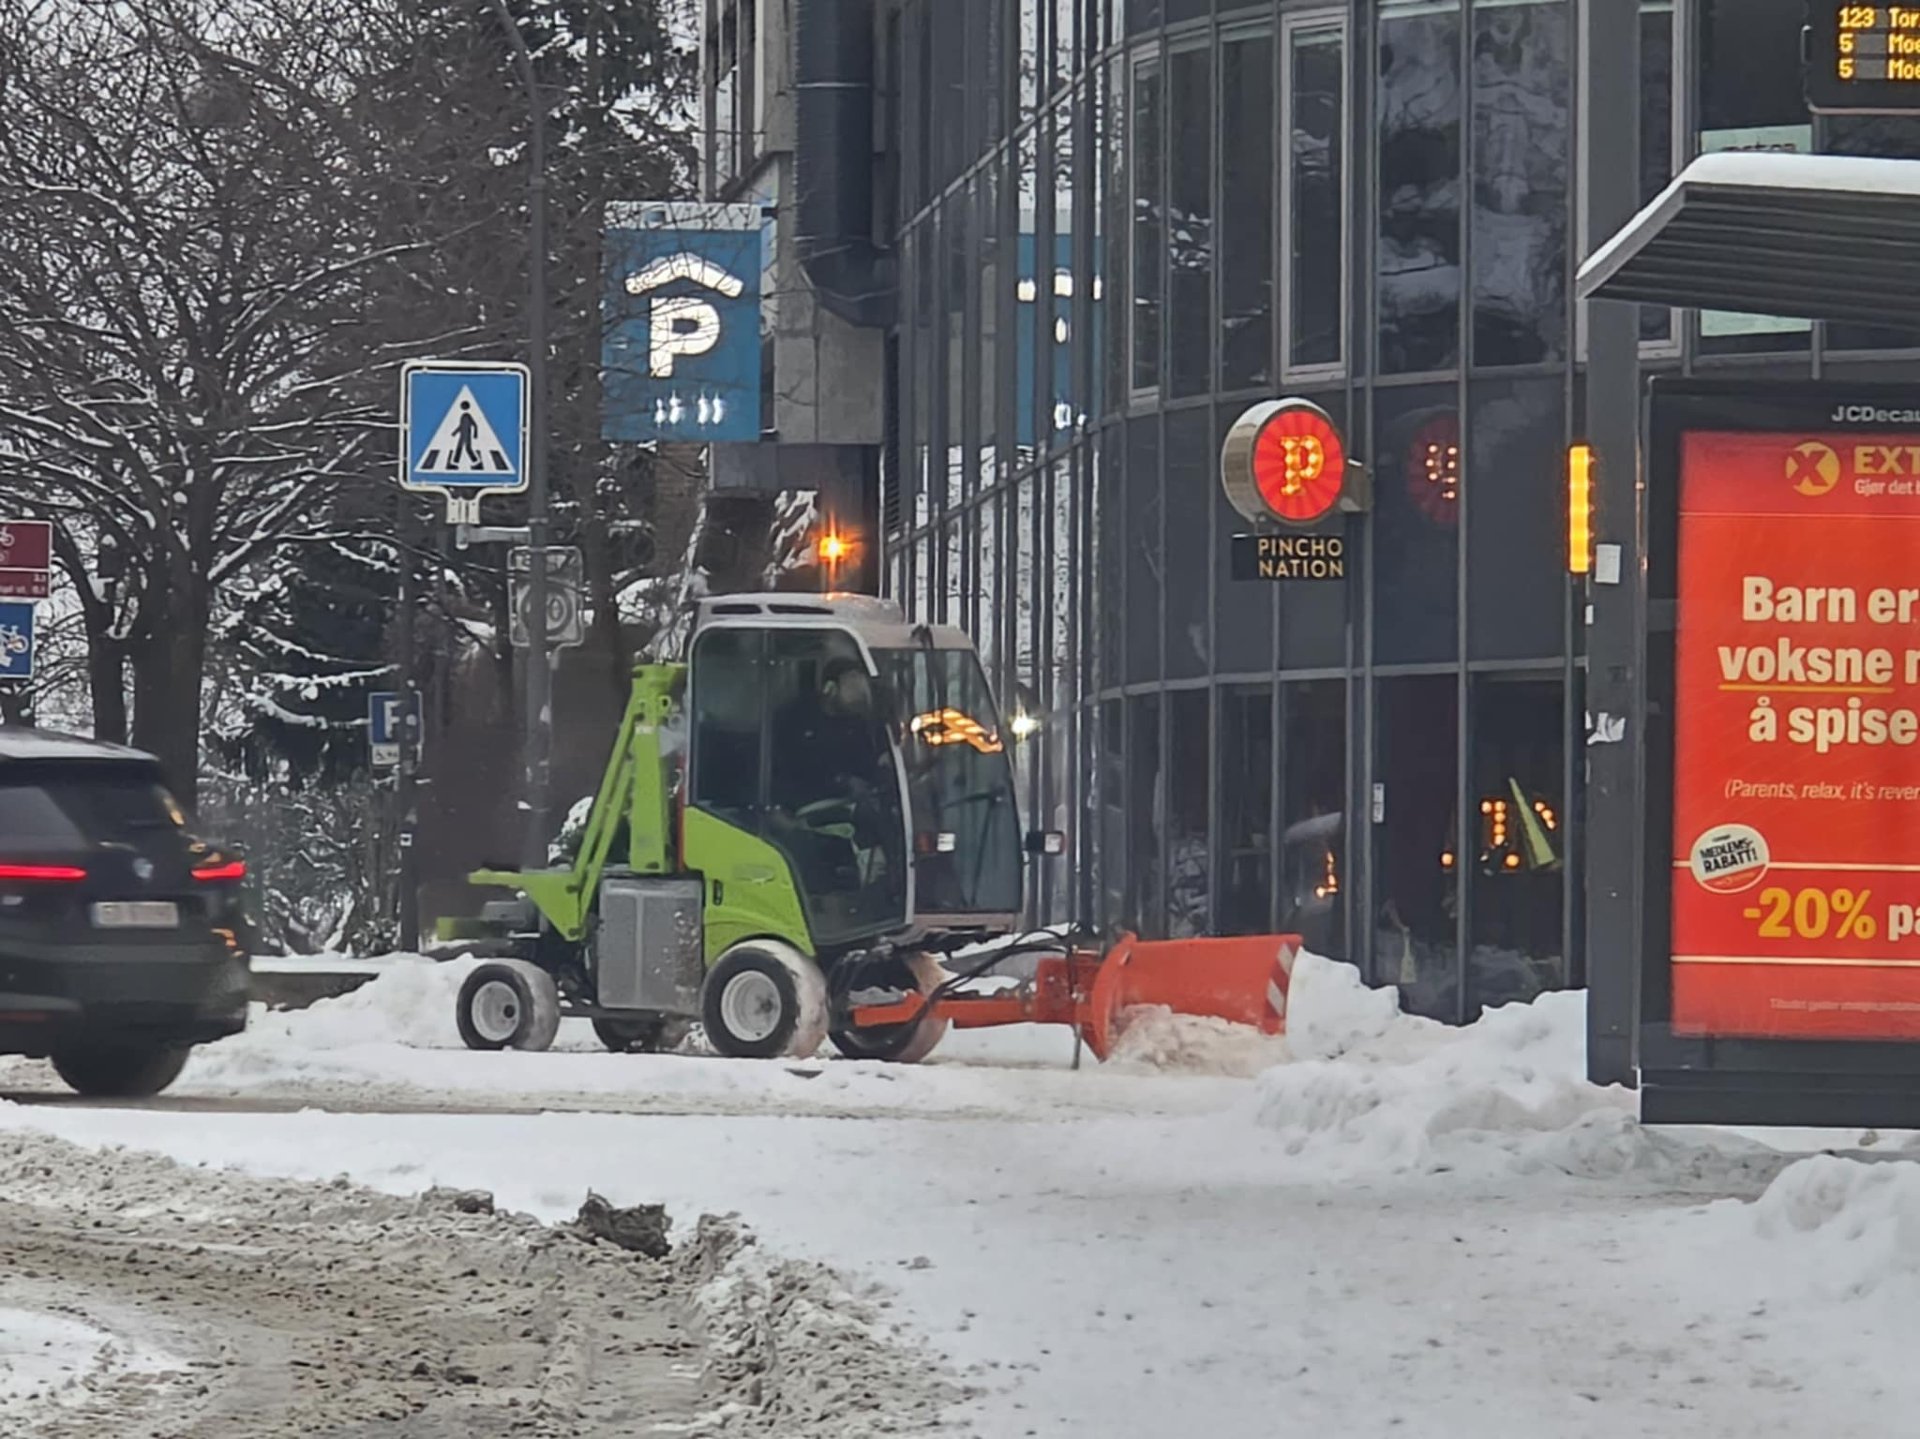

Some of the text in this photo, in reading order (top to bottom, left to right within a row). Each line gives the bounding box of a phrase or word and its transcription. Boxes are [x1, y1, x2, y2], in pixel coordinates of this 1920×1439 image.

[1839, 6, 1875, 28] 123
[1839, 33, 1854, 53] 5
[1839, 59, 1854, 79] 5
[650, 297, 720, 377] P
[1281, 435, 1324, 495] P
[1258, 538, 1343, 557] PINCHO
[1258, 559, 1344, 578] NATION
[1742, 576, 1920, 623] Barn er
[1717, 637, 1894, 684] voksne
[1749, 696, 1918, 754] å spise
[1724, 779, 1798, 800] (Parents,
[1801, 781, 1846, 801] relax,
[1850, 781, 1875, 800] it's
[1703, 847, 1758, 873] RABATT!
[1743, 887, 1877, 940] -20%
